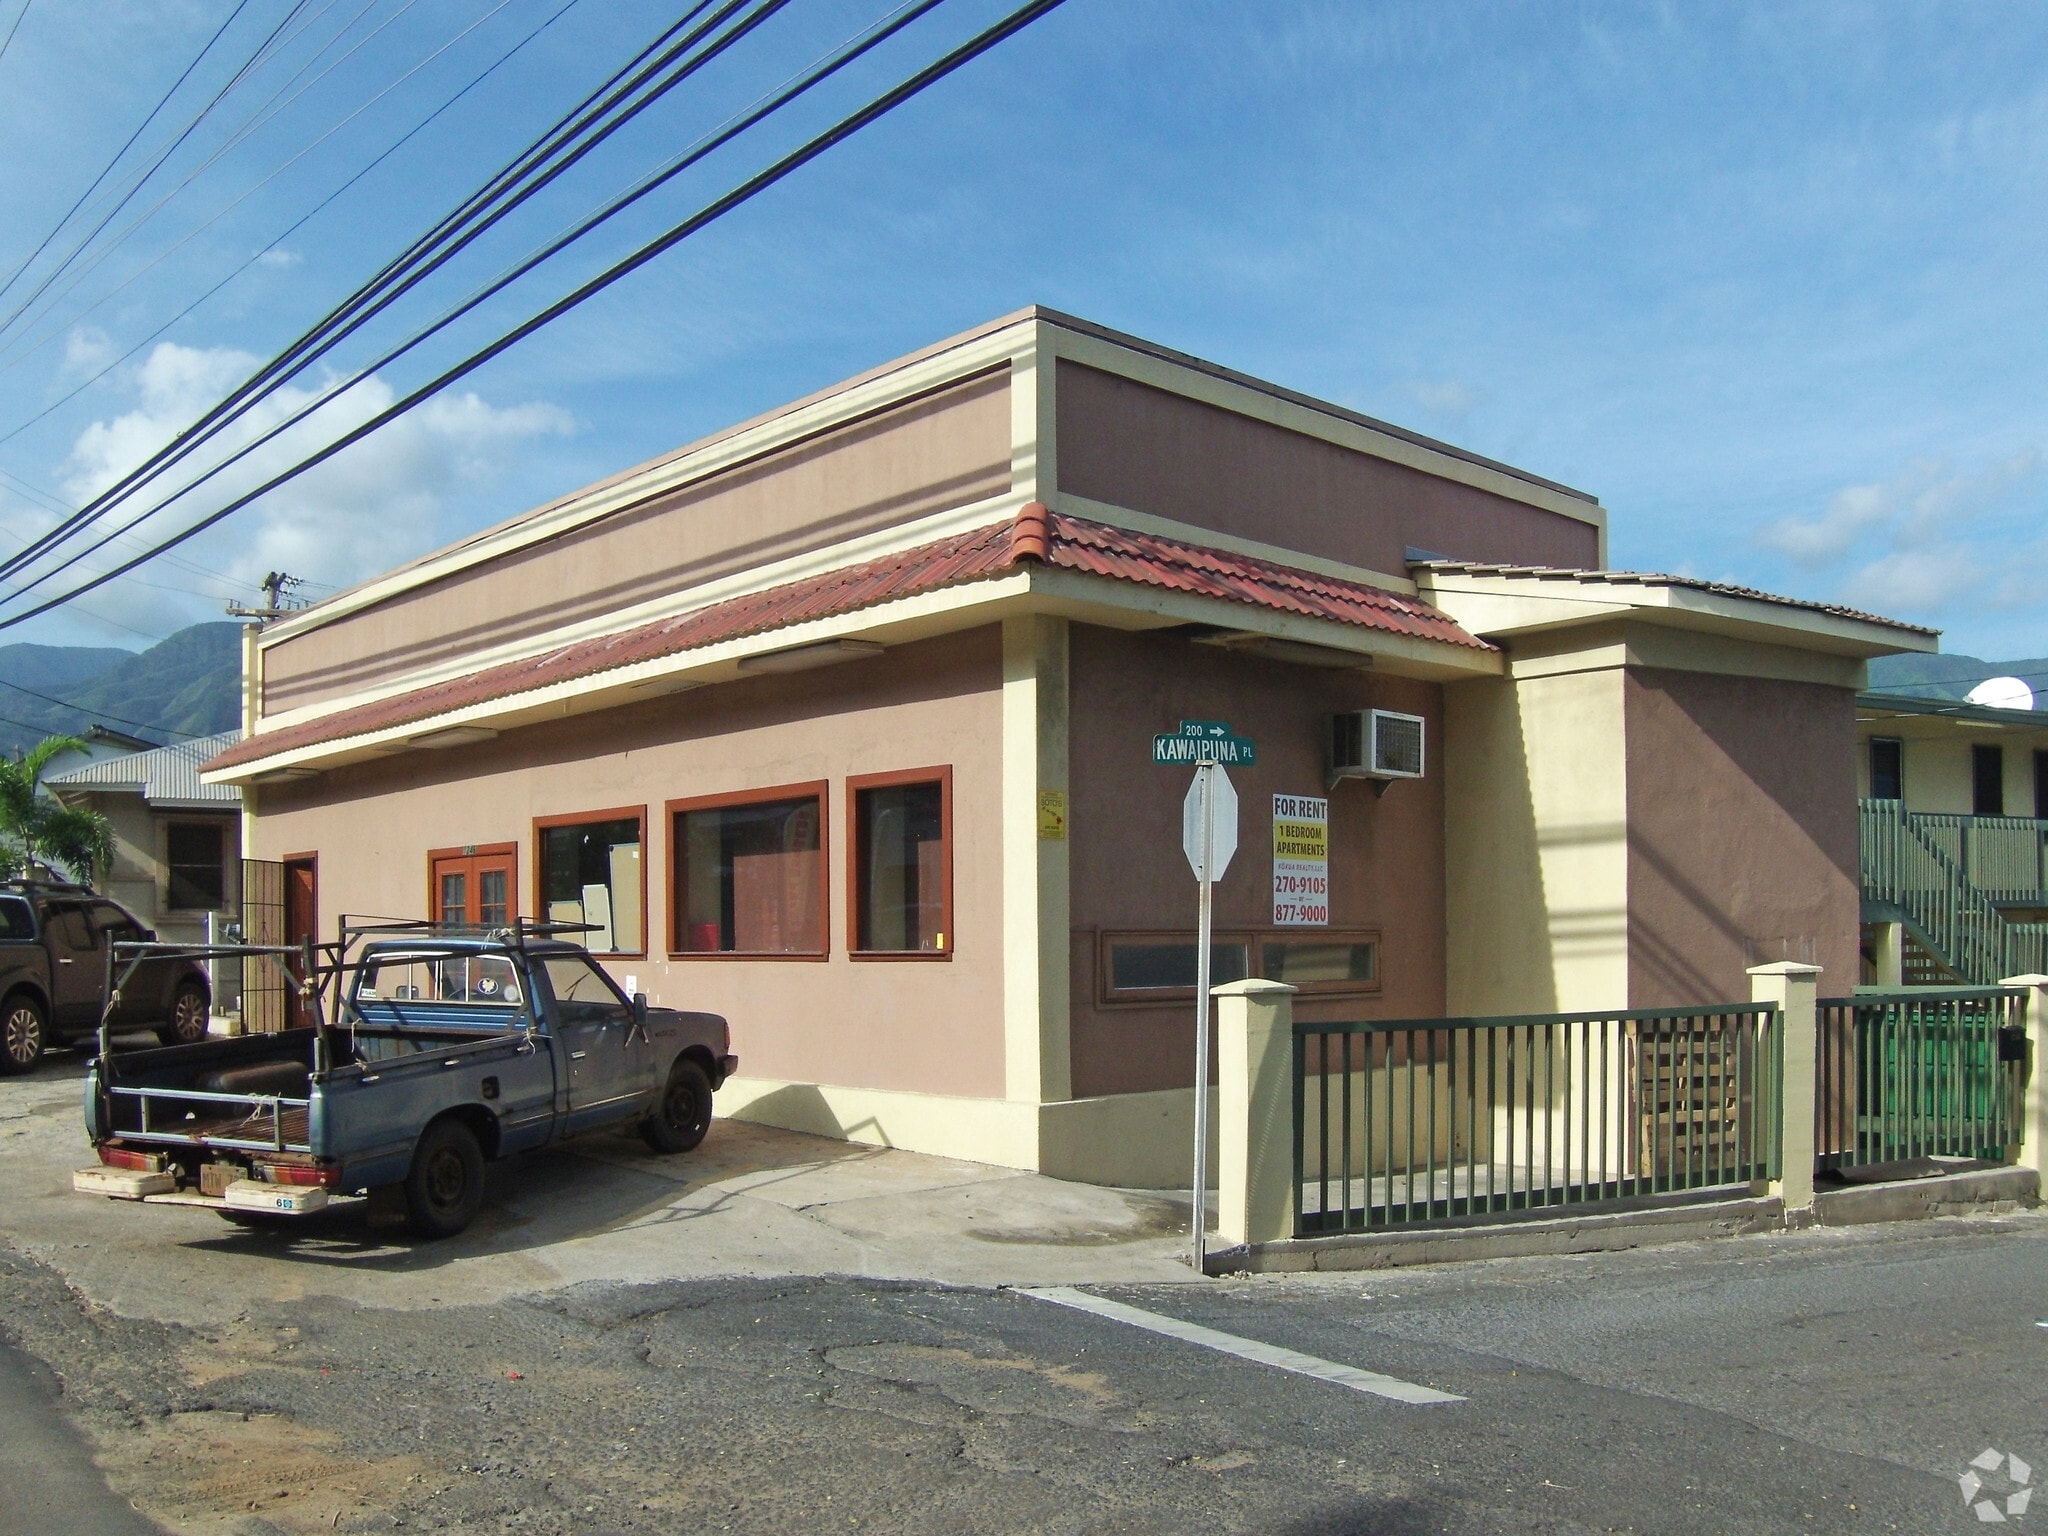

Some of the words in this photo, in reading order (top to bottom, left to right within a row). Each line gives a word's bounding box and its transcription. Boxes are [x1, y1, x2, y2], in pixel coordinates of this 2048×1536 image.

[1186, 725, 1203, 736] 200
[1156, 738, 1238, 761] KAWAIPUNA
[1243, 746, 1253, 757] PL
[1275, 797, 1296, 817] FOR
[1299, 800, 1327, 819] RENT
[1280, 825, 1284, 837] 1
[1286, 826, 1322, 839] BEDROOM
[1277, 841, 1325, 856] APARTMENTS
[1276, 875, 1326, 895] 270-9105
[1276, 904, 1327, 922] 877-9000
